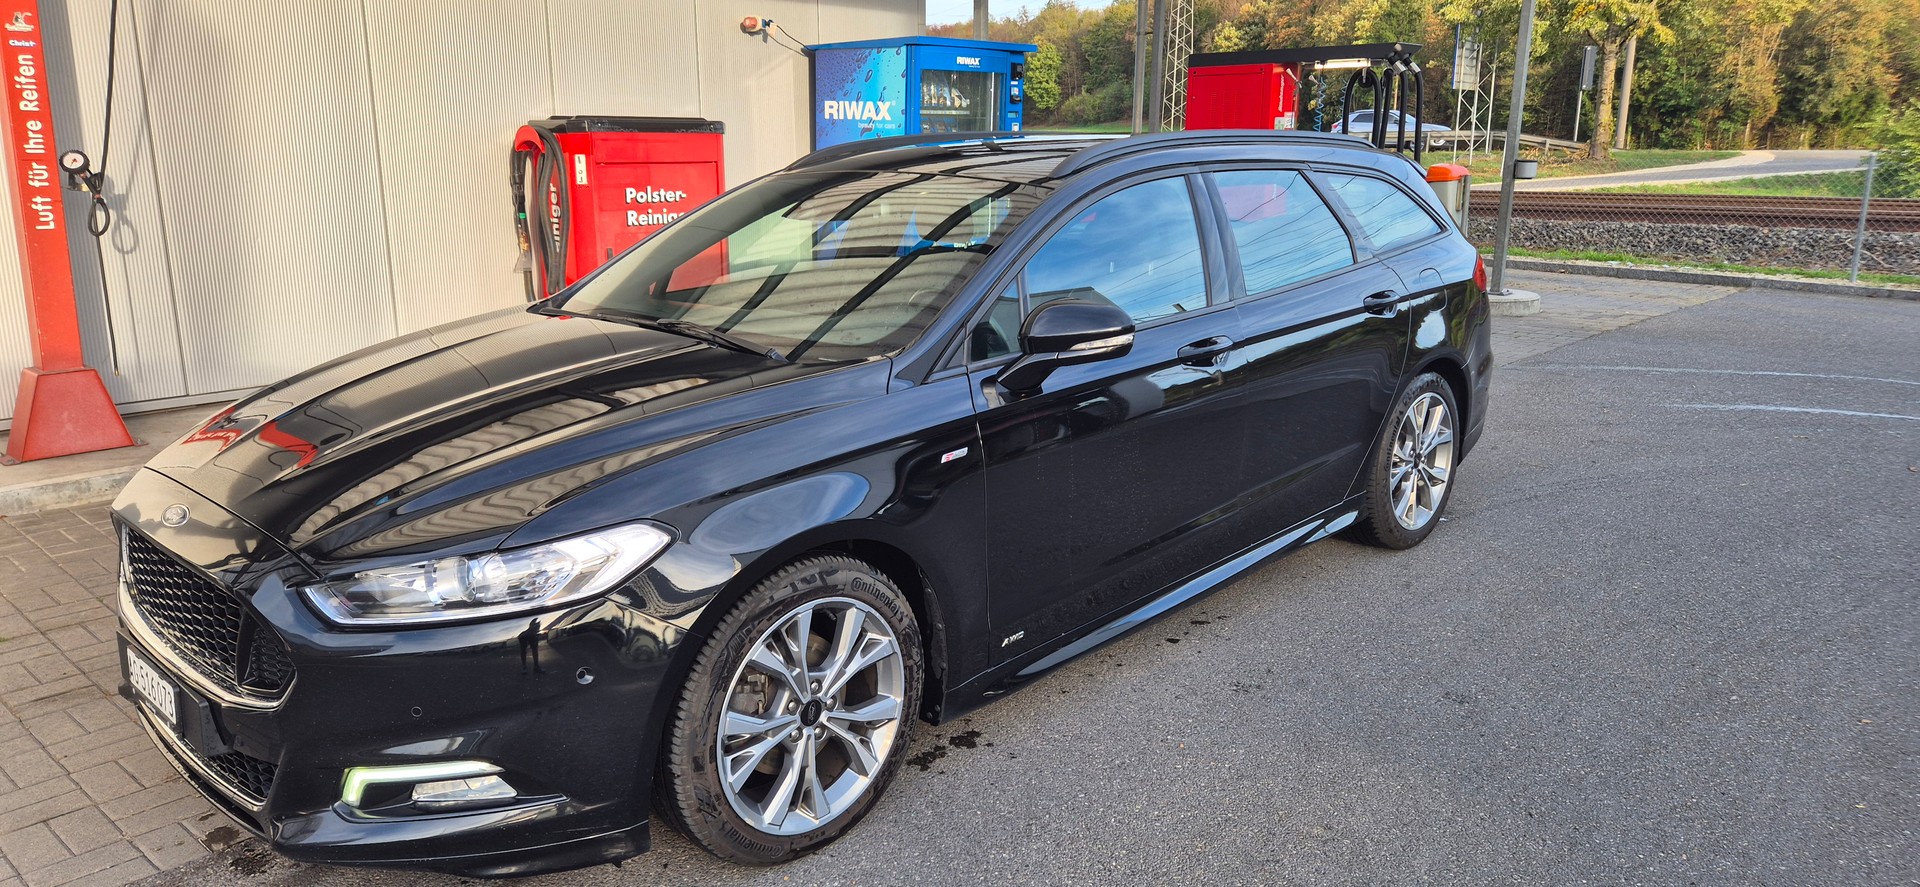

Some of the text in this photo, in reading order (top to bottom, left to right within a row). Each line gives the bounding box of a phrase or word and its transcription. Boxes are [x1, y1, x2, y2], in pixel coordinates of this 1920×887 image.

[956, 56, 981, 65] RIWAX
[824, 100, 892, 120] RIWAX
[14, 54, 55, 230] Luft für Ihre Reifen
[625, 185, 687, 204] Polster-
[850, 576, 902, 620] Continental
